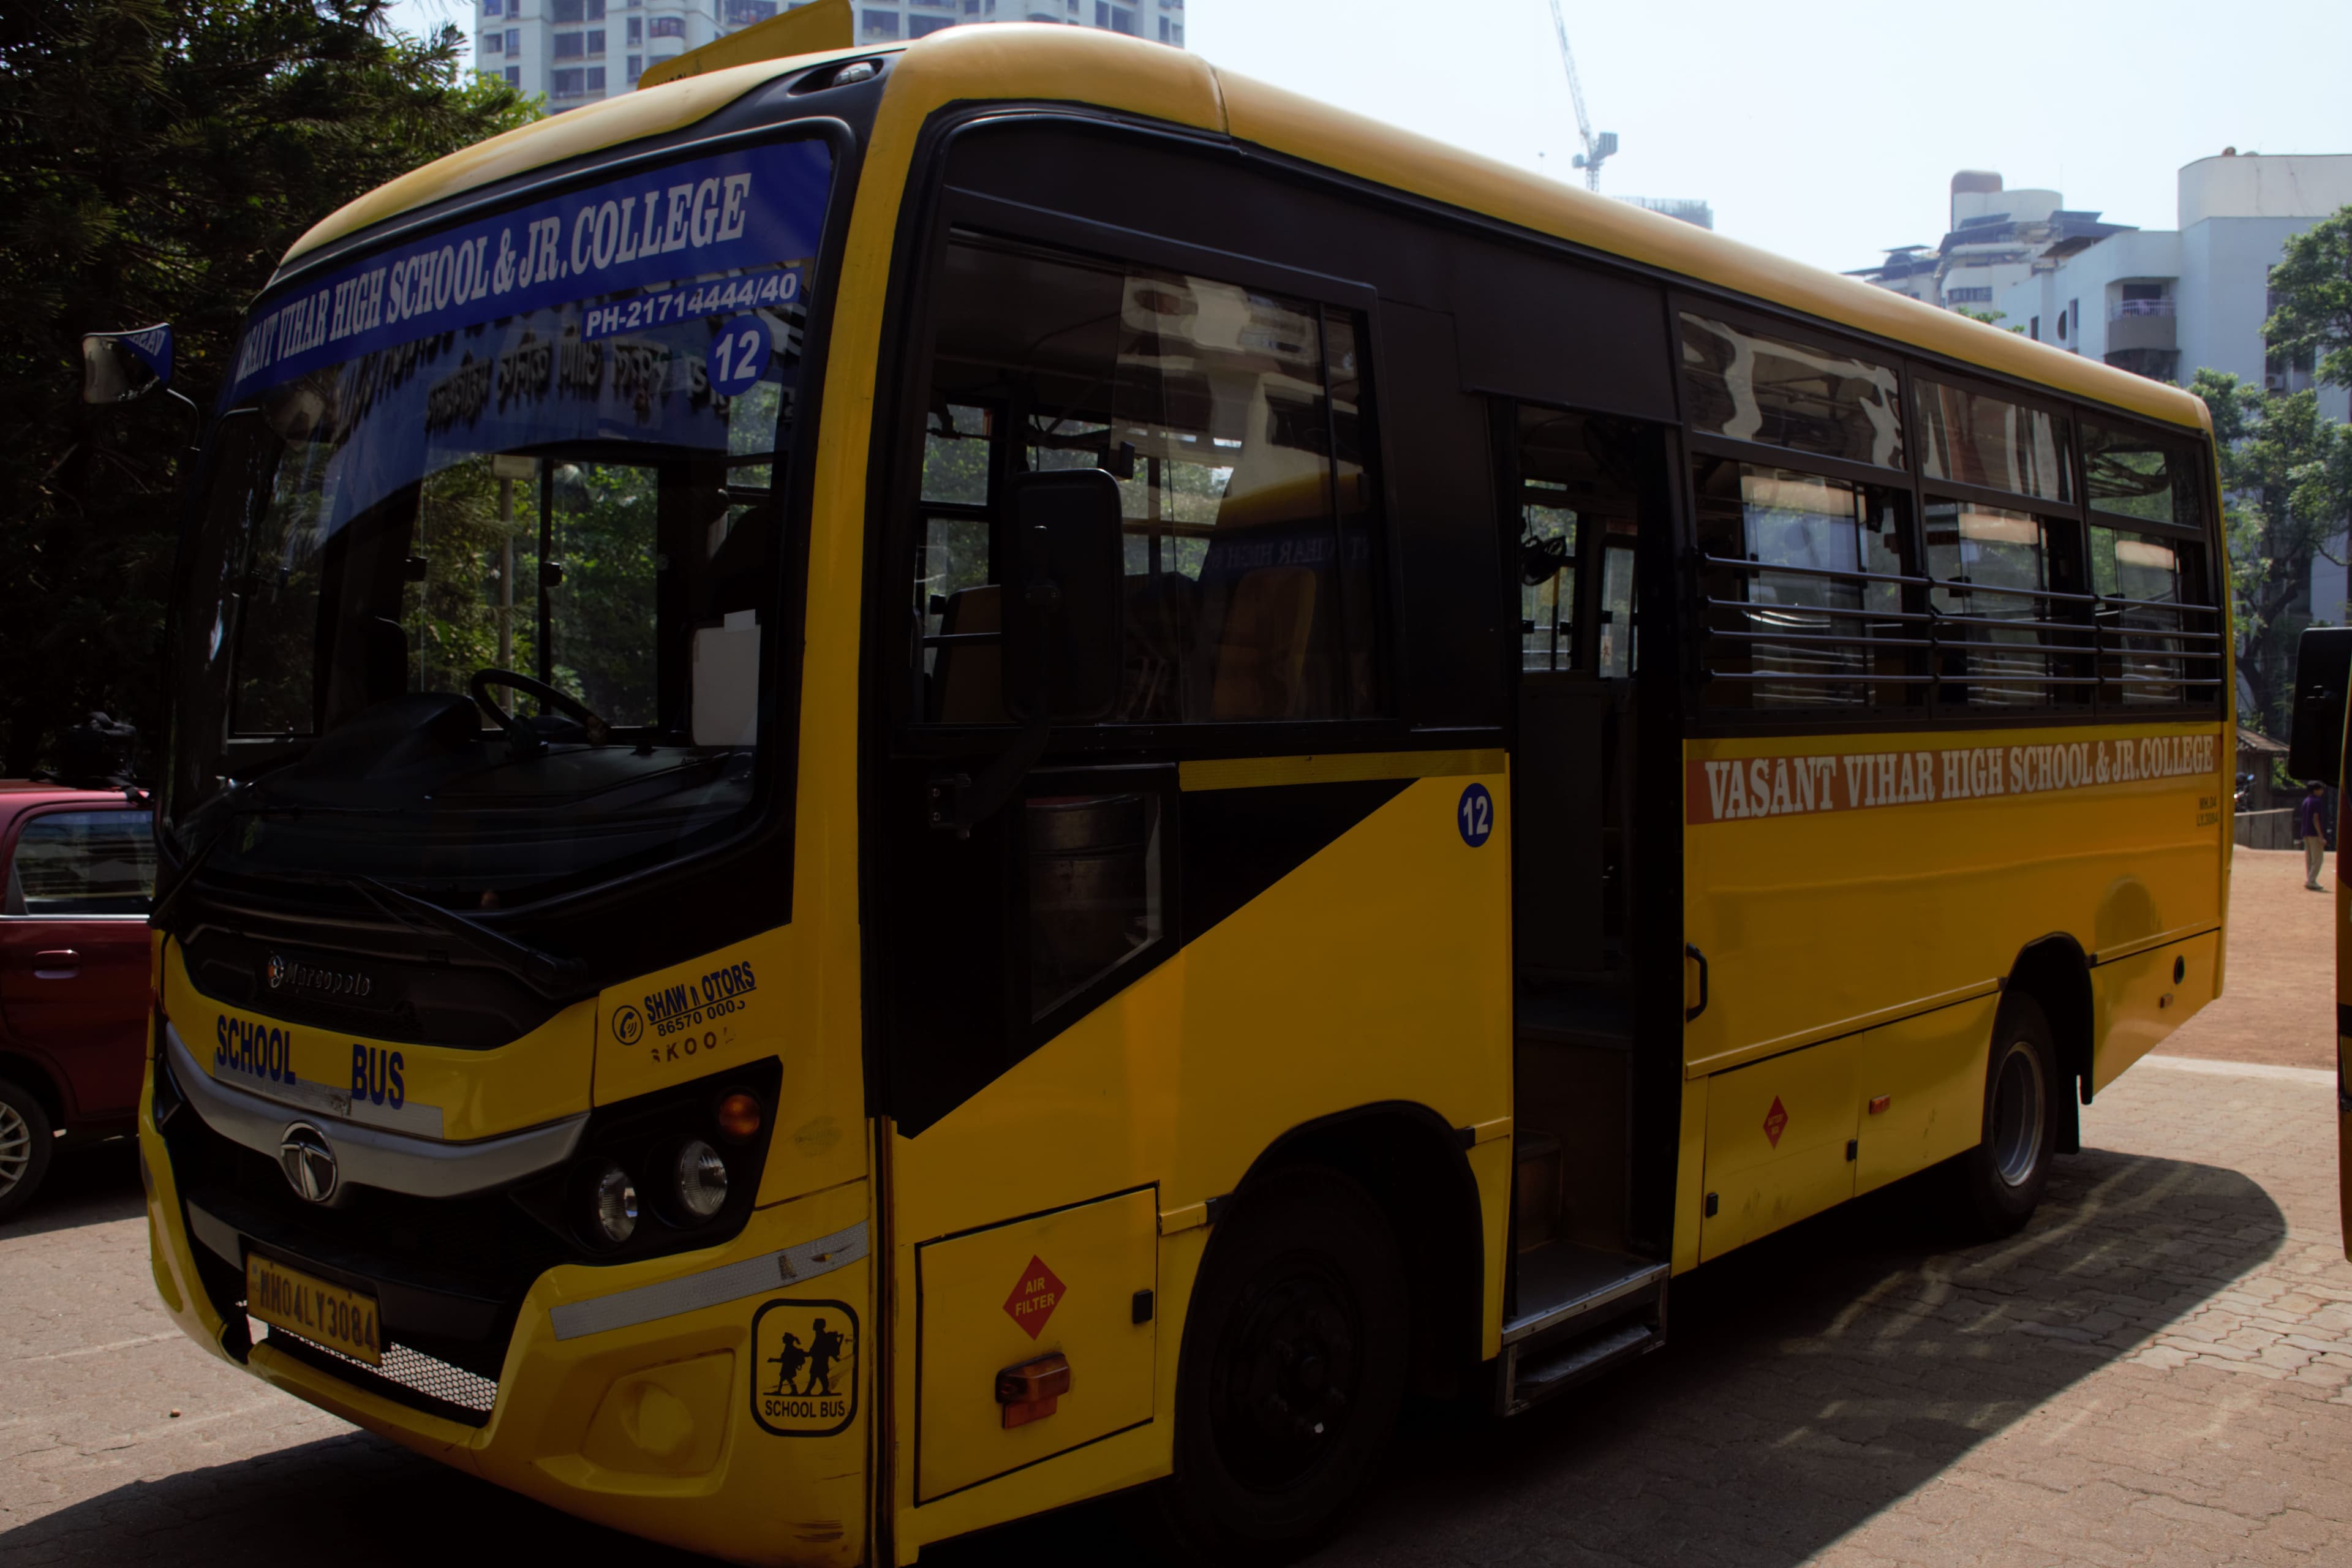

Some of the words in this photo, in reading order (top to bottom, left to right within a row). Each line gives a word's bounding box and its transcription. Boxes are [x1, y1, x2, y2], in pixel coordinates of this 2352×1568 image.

[277, 288, 330, 361] VIHAR
[329, 266, 387, 342] HIGH
[386, 236, 489, 324] SCHOOL
[492, 227, 517, 295] &
[586, 273, 797, 338] PH-21714444/40
[715, 330, 761, 383] 12
[1705, 756, 1836, 820] VASANT
[1843, 752, 1936, 807] VIHAR
[1941, 747, 2004, 799] HIGH
[2010, 742, 2093, 793] SCHOOL
[2096, 742, 2111, 784] &
[1462, 794, 1489, 836] 12
[657, 1011, 702, 1036] 86570
[217, 1014, 295, 1085] SCHOOL
[352, 1044, 404, 1110] BUS
[1015, 1292, 1055, 1317] FILTER
[1025, 1277, 1046, 1295] AIR
[765, 1400, 816, 1419] SCHOOL
[820, 1400, 845, 1417] BUS
